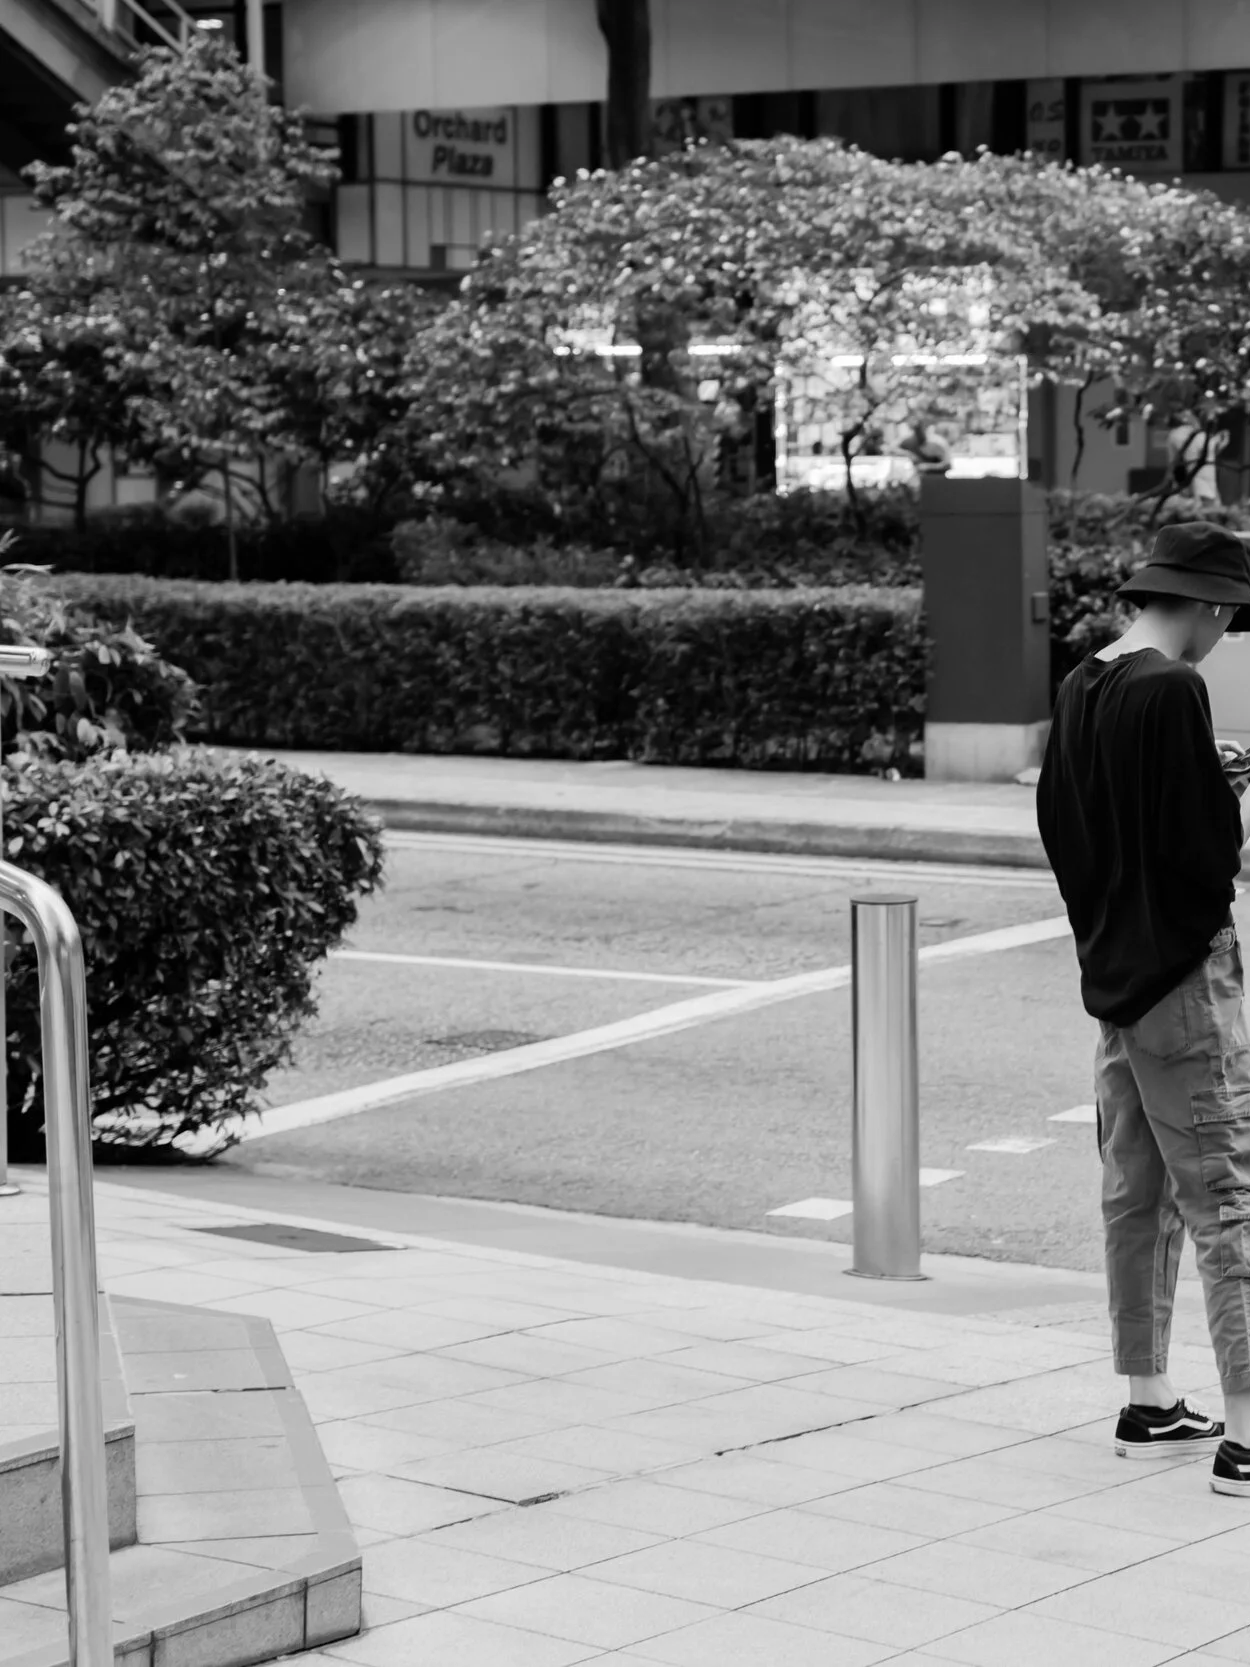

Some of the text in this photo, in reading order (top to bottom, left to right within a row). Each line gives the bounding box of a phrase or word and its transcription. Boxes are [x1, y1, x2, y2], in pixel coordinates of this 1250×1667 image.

[413, 108, 508, 144] Orchard
[431, 144, 495, 178] Plaza
[1090, 144, 1169, 162] TAMIYA
